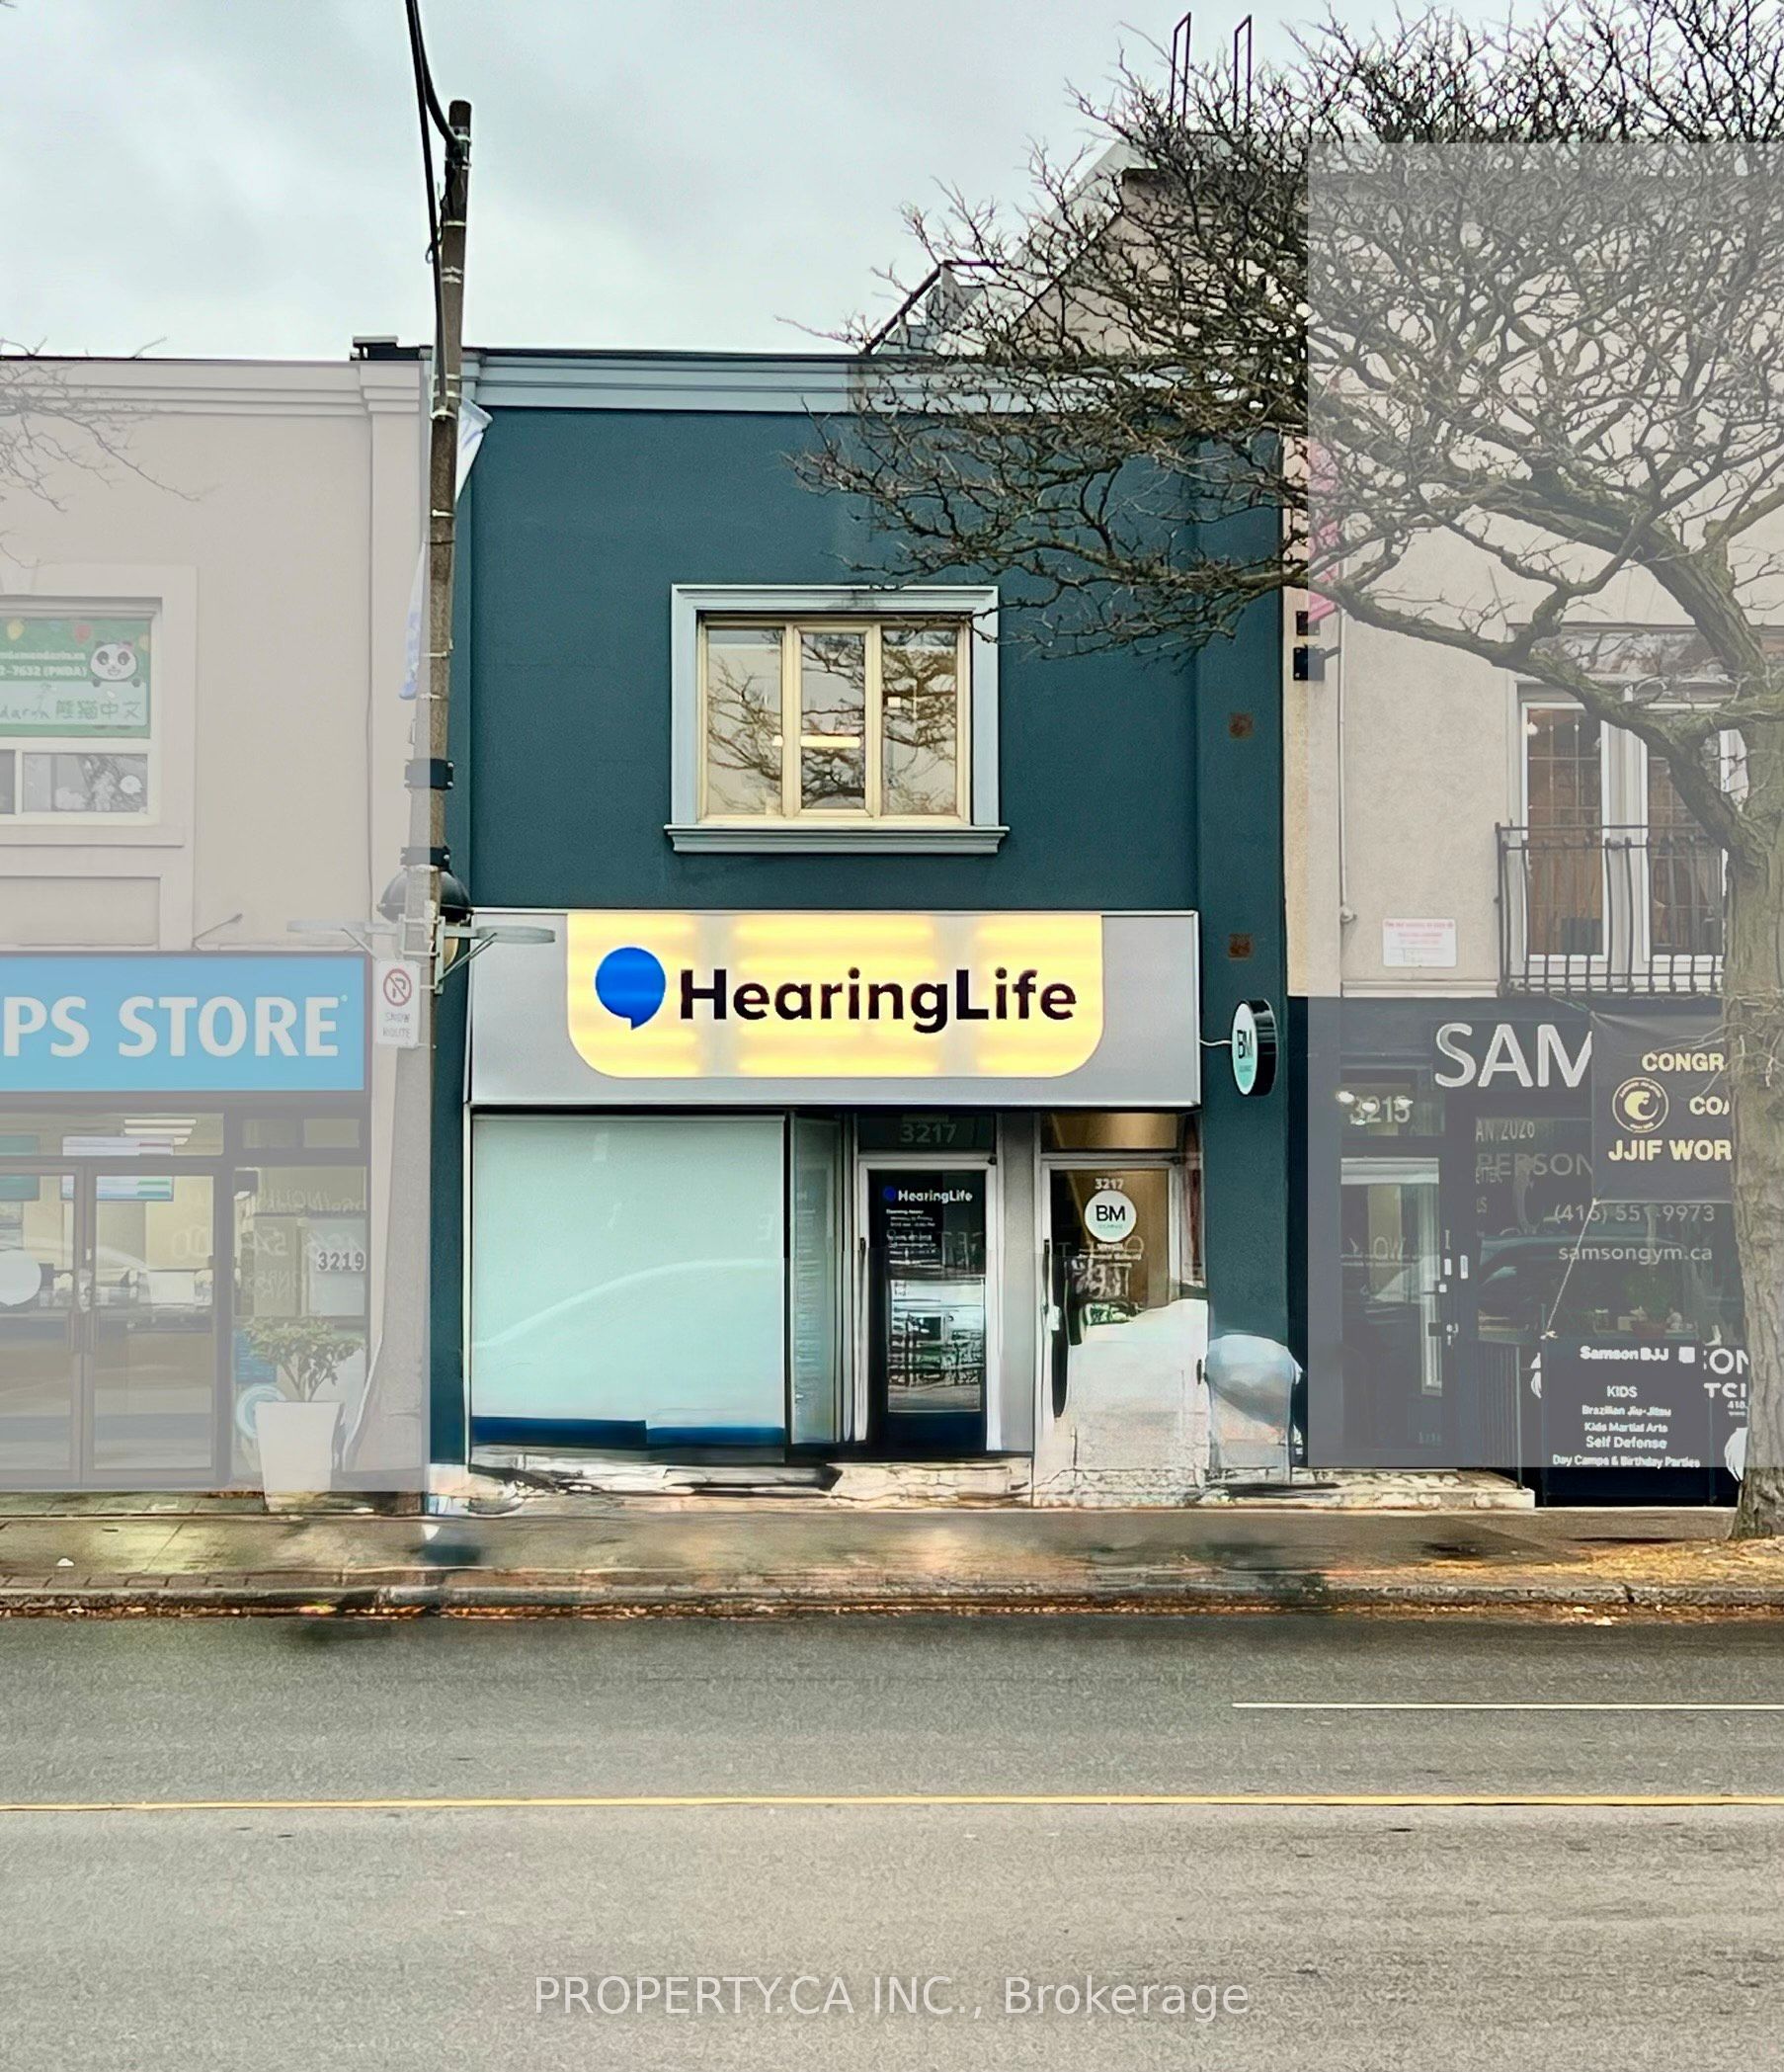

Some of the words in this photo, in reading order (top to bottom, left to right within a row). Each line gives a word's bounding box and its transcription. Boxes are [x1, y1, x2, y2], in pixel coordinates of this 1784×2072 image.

[680, 966, 1077, 1035] HearingLife
[3, 995, 90, 1058] PS
[118, 995, 339, 1058] STORE
[1348, 1095, 1411, 1124] 3215
[901, 1122, 957, 1143] 3217
[1608, 1139, 1662, 1162] JJIF
[1668, 1139, 1733, 1162] WOR
[1095, 1178, 1124, 1190] 3217
[898, 1189, 973, 1203] HearingLife
[1095, 1204, 1125, 1221] BM
[317, 1251, 365, 1272] 3219
[1559, 1246, 1713, 1266] samsongym.ca
[1580, 1346, 1639, 1361] Samson
[1640, 1347, 1669, 1362] BJJ
[1606, 1385, 1638, 1398] KIDS
[1581, 1405, 1625, 1416] Brazilian
[1584, 1422, 1607, 1432] Kids
[1609, 1422, 1645, 1433] Martial
[1646, 1423, 1668, 1433] Arts
[1586, 1436, 1611, 1449] Self
[1613, 1436, 1667, 1450] Defense
[1552, 1454, 1573, 1466] Day
[1574, 1454, 1609, 1467] Camps
[1620, 1455, 1663, 1469] Birthday
[1664, 1456, 1701, 1468] Parties
